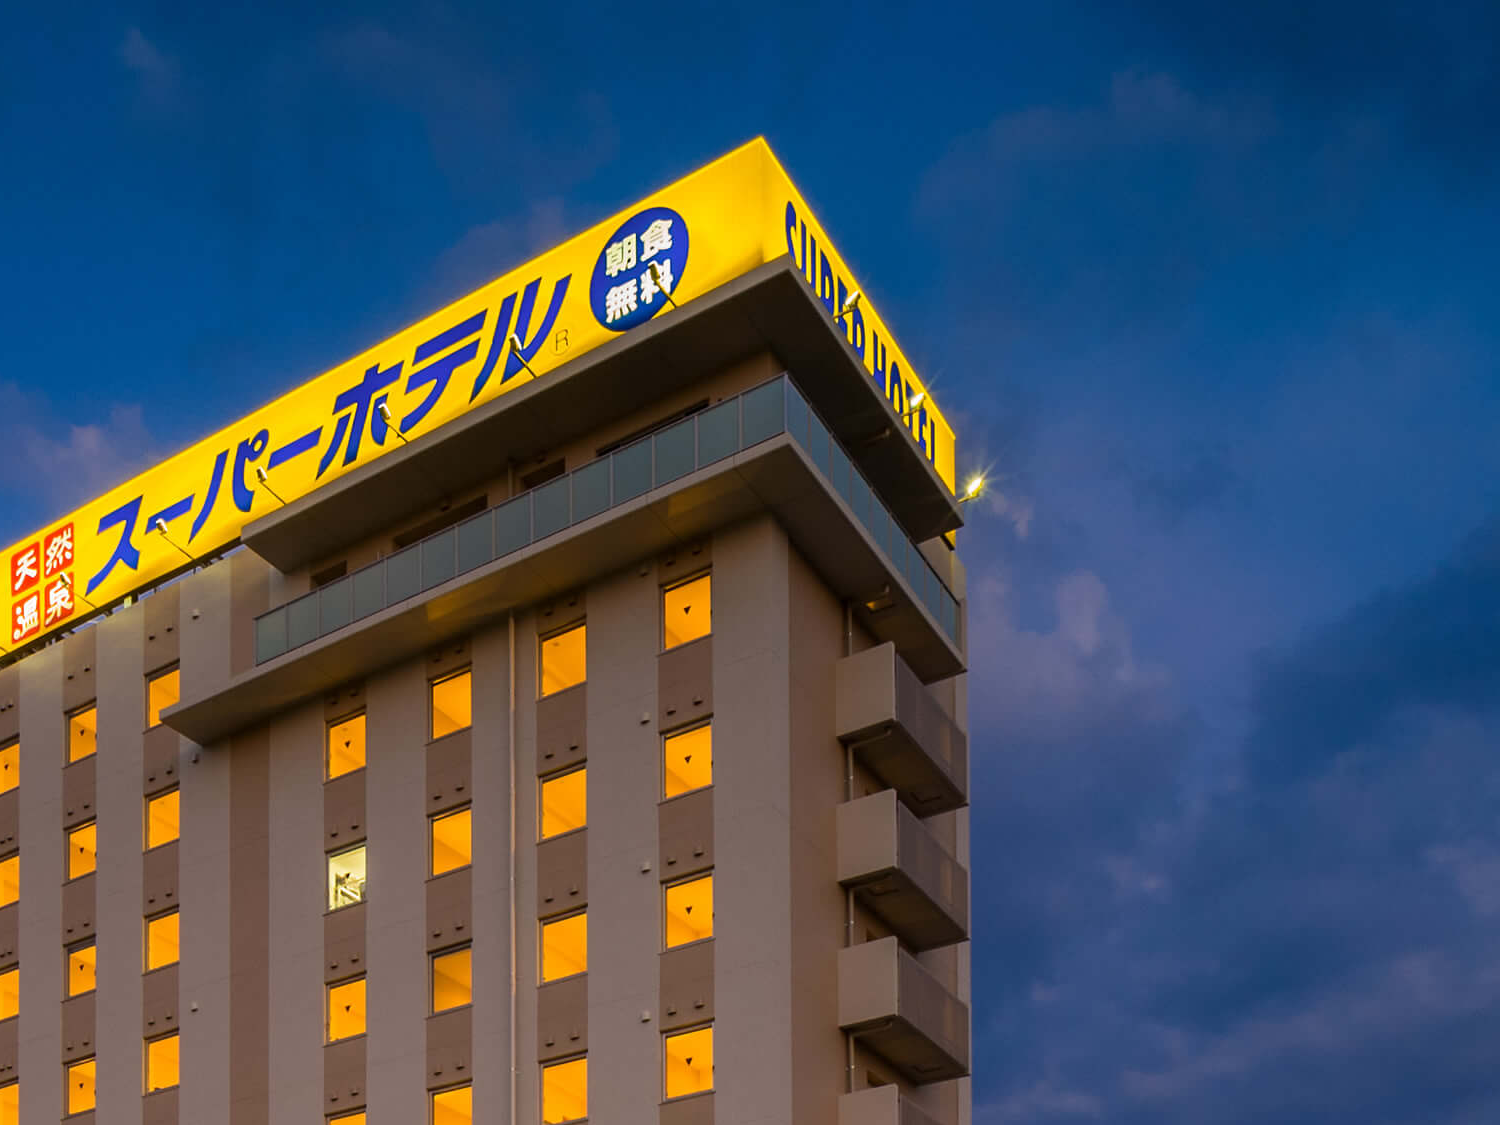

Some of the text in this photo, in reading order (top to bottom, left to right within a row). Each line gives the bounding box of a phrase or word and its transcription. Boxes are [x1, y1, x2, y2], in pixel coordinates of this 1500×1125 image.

[605, 219, 674, 278] 朝食
[605, 258, 674, 324] 無料
[85, 272, 572, 597] スーパーホテル
[14, 527, 73, 591] 天然
[13, 577, 74, 641] 温泉
